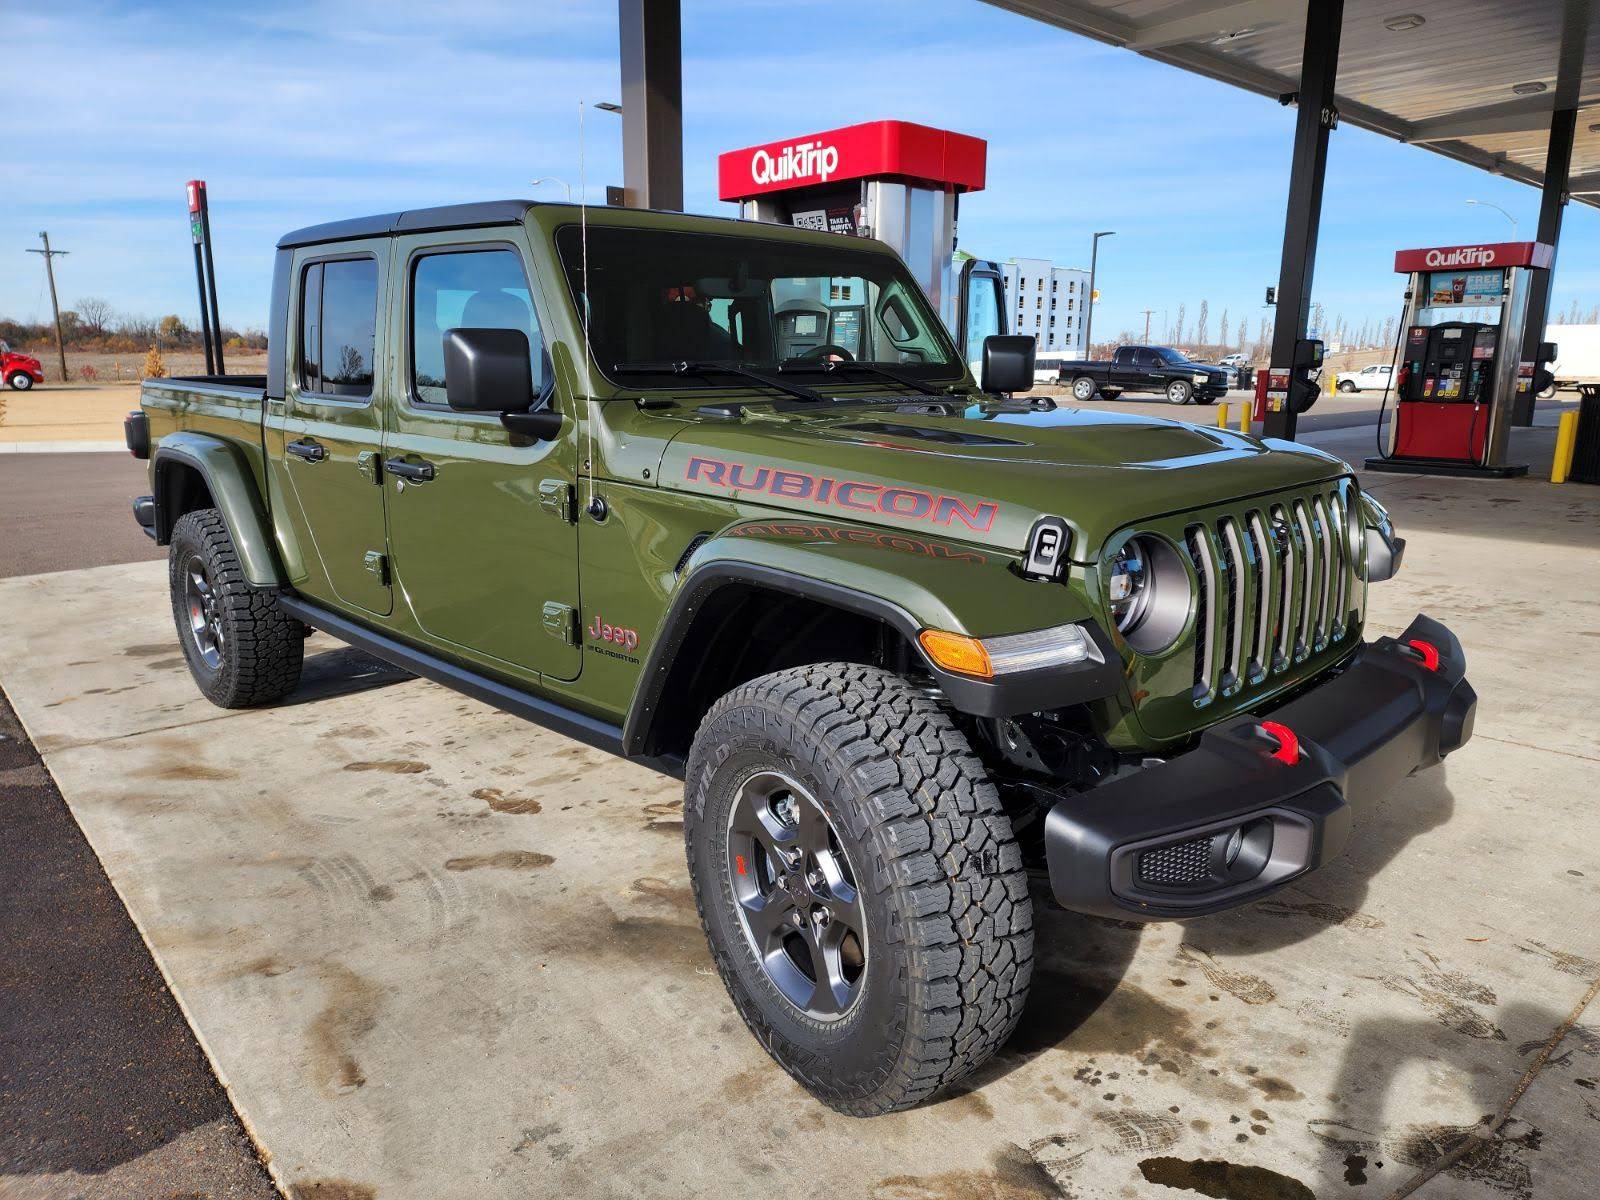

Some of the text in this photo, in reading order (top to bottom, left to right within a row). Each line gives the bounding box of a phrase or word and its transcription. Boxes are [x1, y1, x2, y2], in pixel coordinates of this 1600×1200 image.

[1321, 107, 1330, 124] 13
[752, 141, 838, 184] QuikTrip
[829, 217, 844, 225] TAKE
[1425, 247, 1495, 267] QuikTrip
[1467, 274, 1500, 284] FREE
[686, 456, 998, 532] RUBICON
[588, 615, 639, 654] Jeep
[594, 646, 641, 665] GLADIATOR
